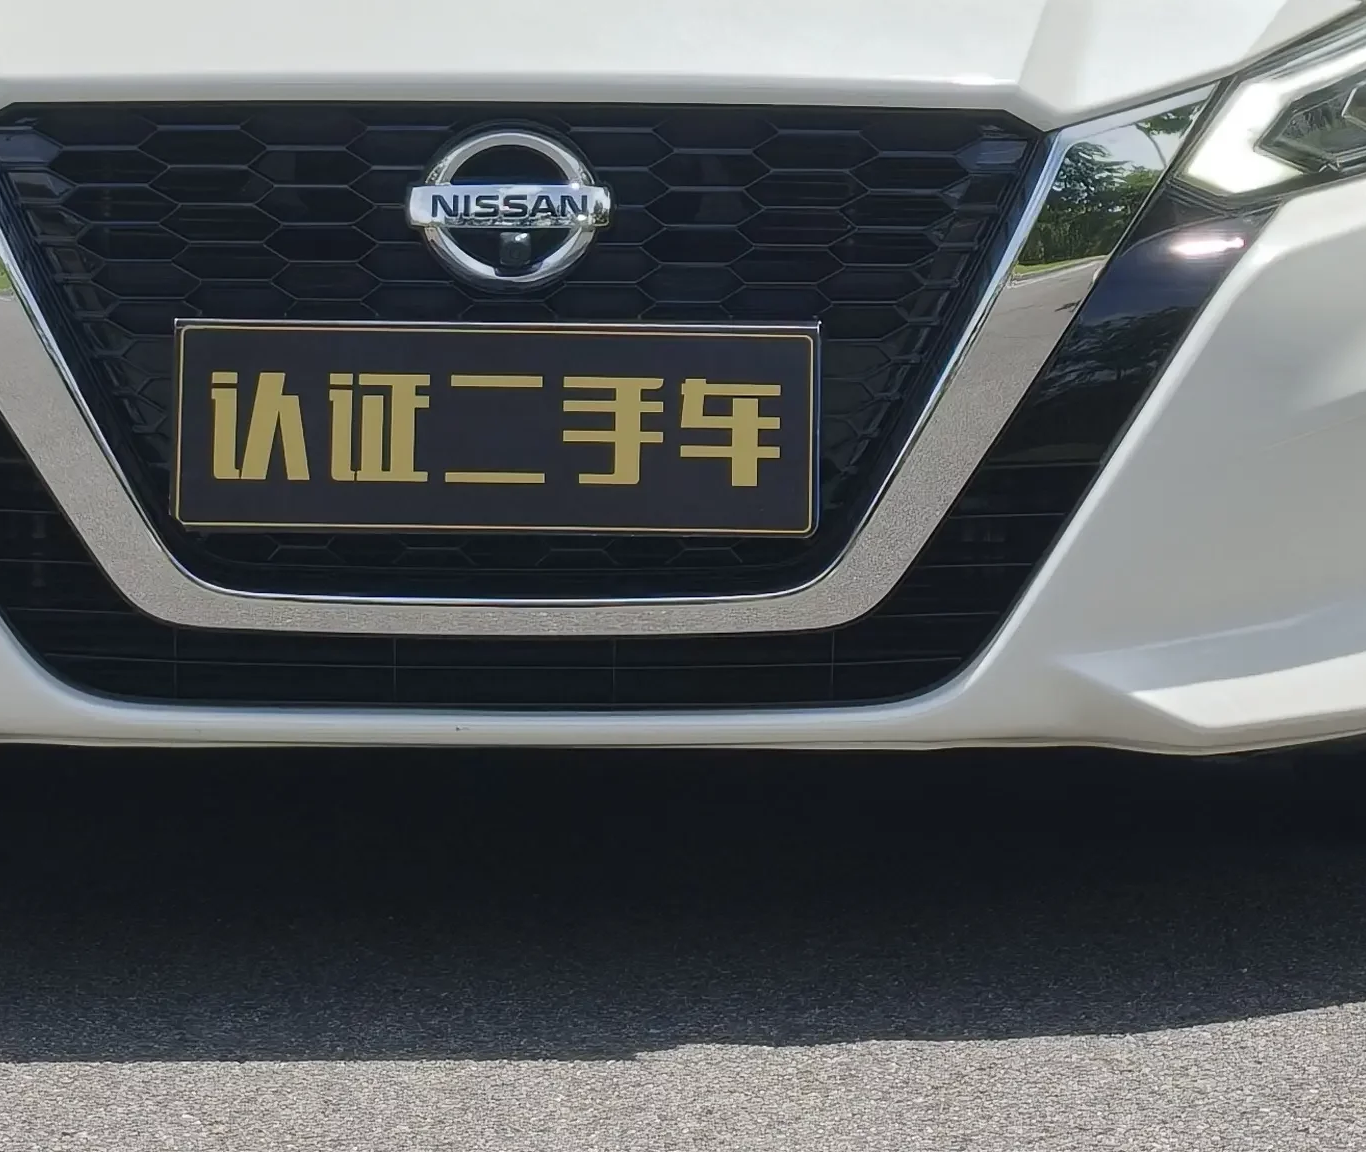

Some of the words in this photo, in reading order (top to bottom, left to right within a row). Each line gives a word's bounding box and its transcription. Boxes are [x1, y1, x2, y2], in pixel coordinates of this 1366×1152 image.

[431, 194, 588, 218] NISSAN
[211, 371, 781, 487] 认证二手车
